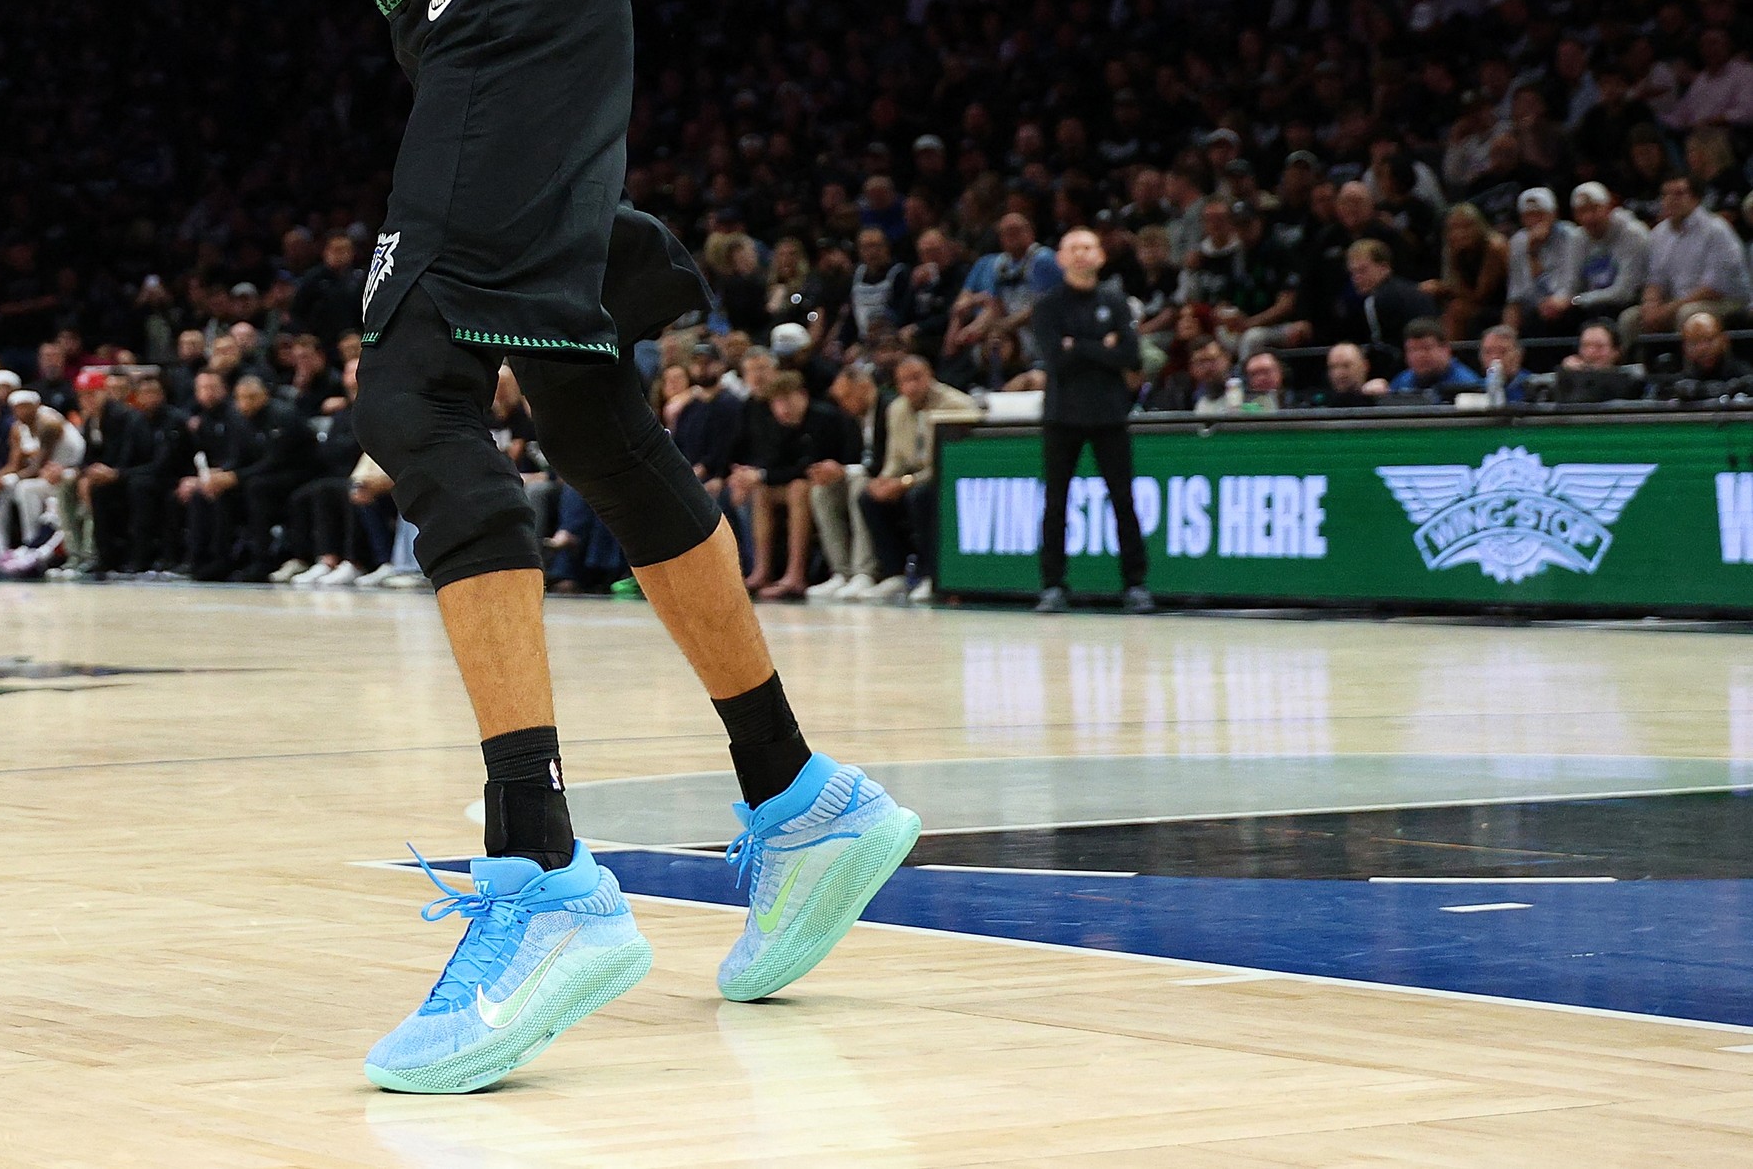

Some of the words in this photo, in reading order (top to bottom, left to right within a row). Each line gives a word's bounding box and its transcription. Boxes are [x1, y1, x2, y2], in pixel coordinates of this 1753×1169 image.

[955, 475, 1161, 558] WINSTP
[1167, 474, 1213, 558] IS
[1218, 474, 1330, 559] HERE
